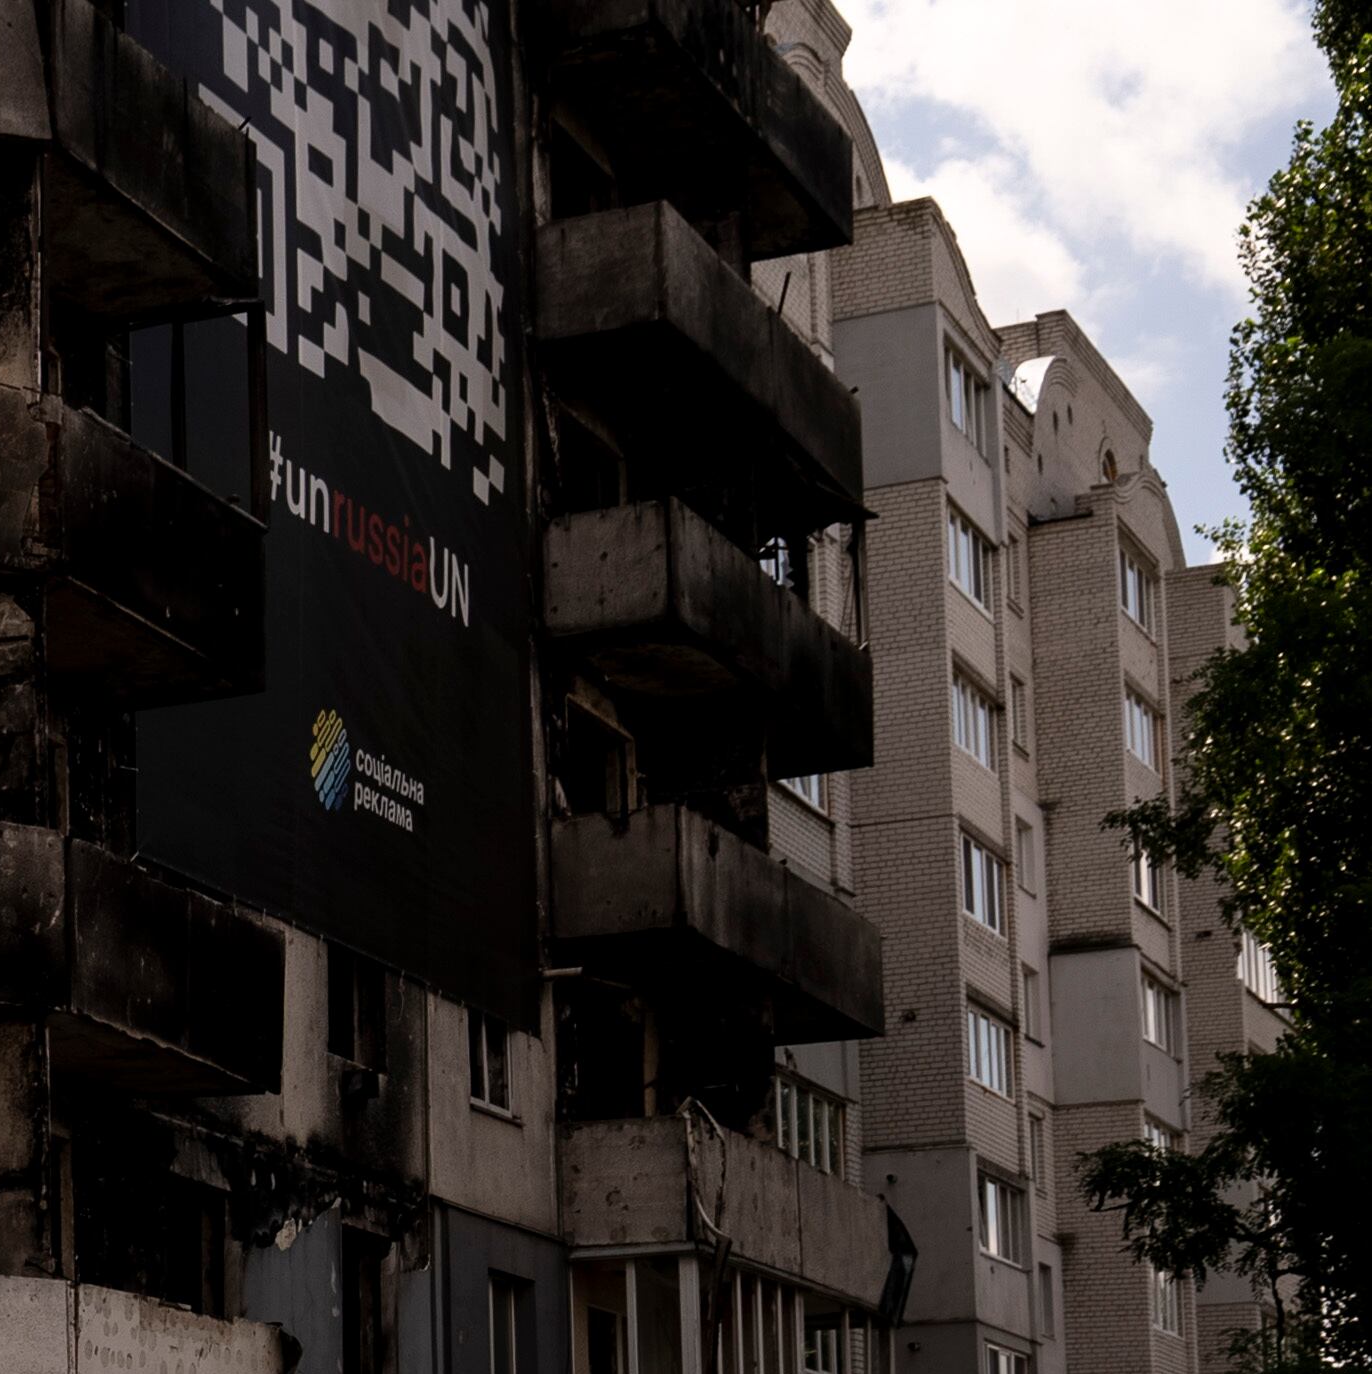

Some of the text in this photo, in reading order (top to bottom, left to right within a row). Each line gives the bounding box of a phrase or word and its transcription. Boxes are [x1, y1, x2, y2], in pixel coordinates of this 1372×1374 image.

[269, 430, 470, 628] #unrussiaUN
[355, 748, 425, 806] соціальна
[353, 781, 414, 833] реклама
